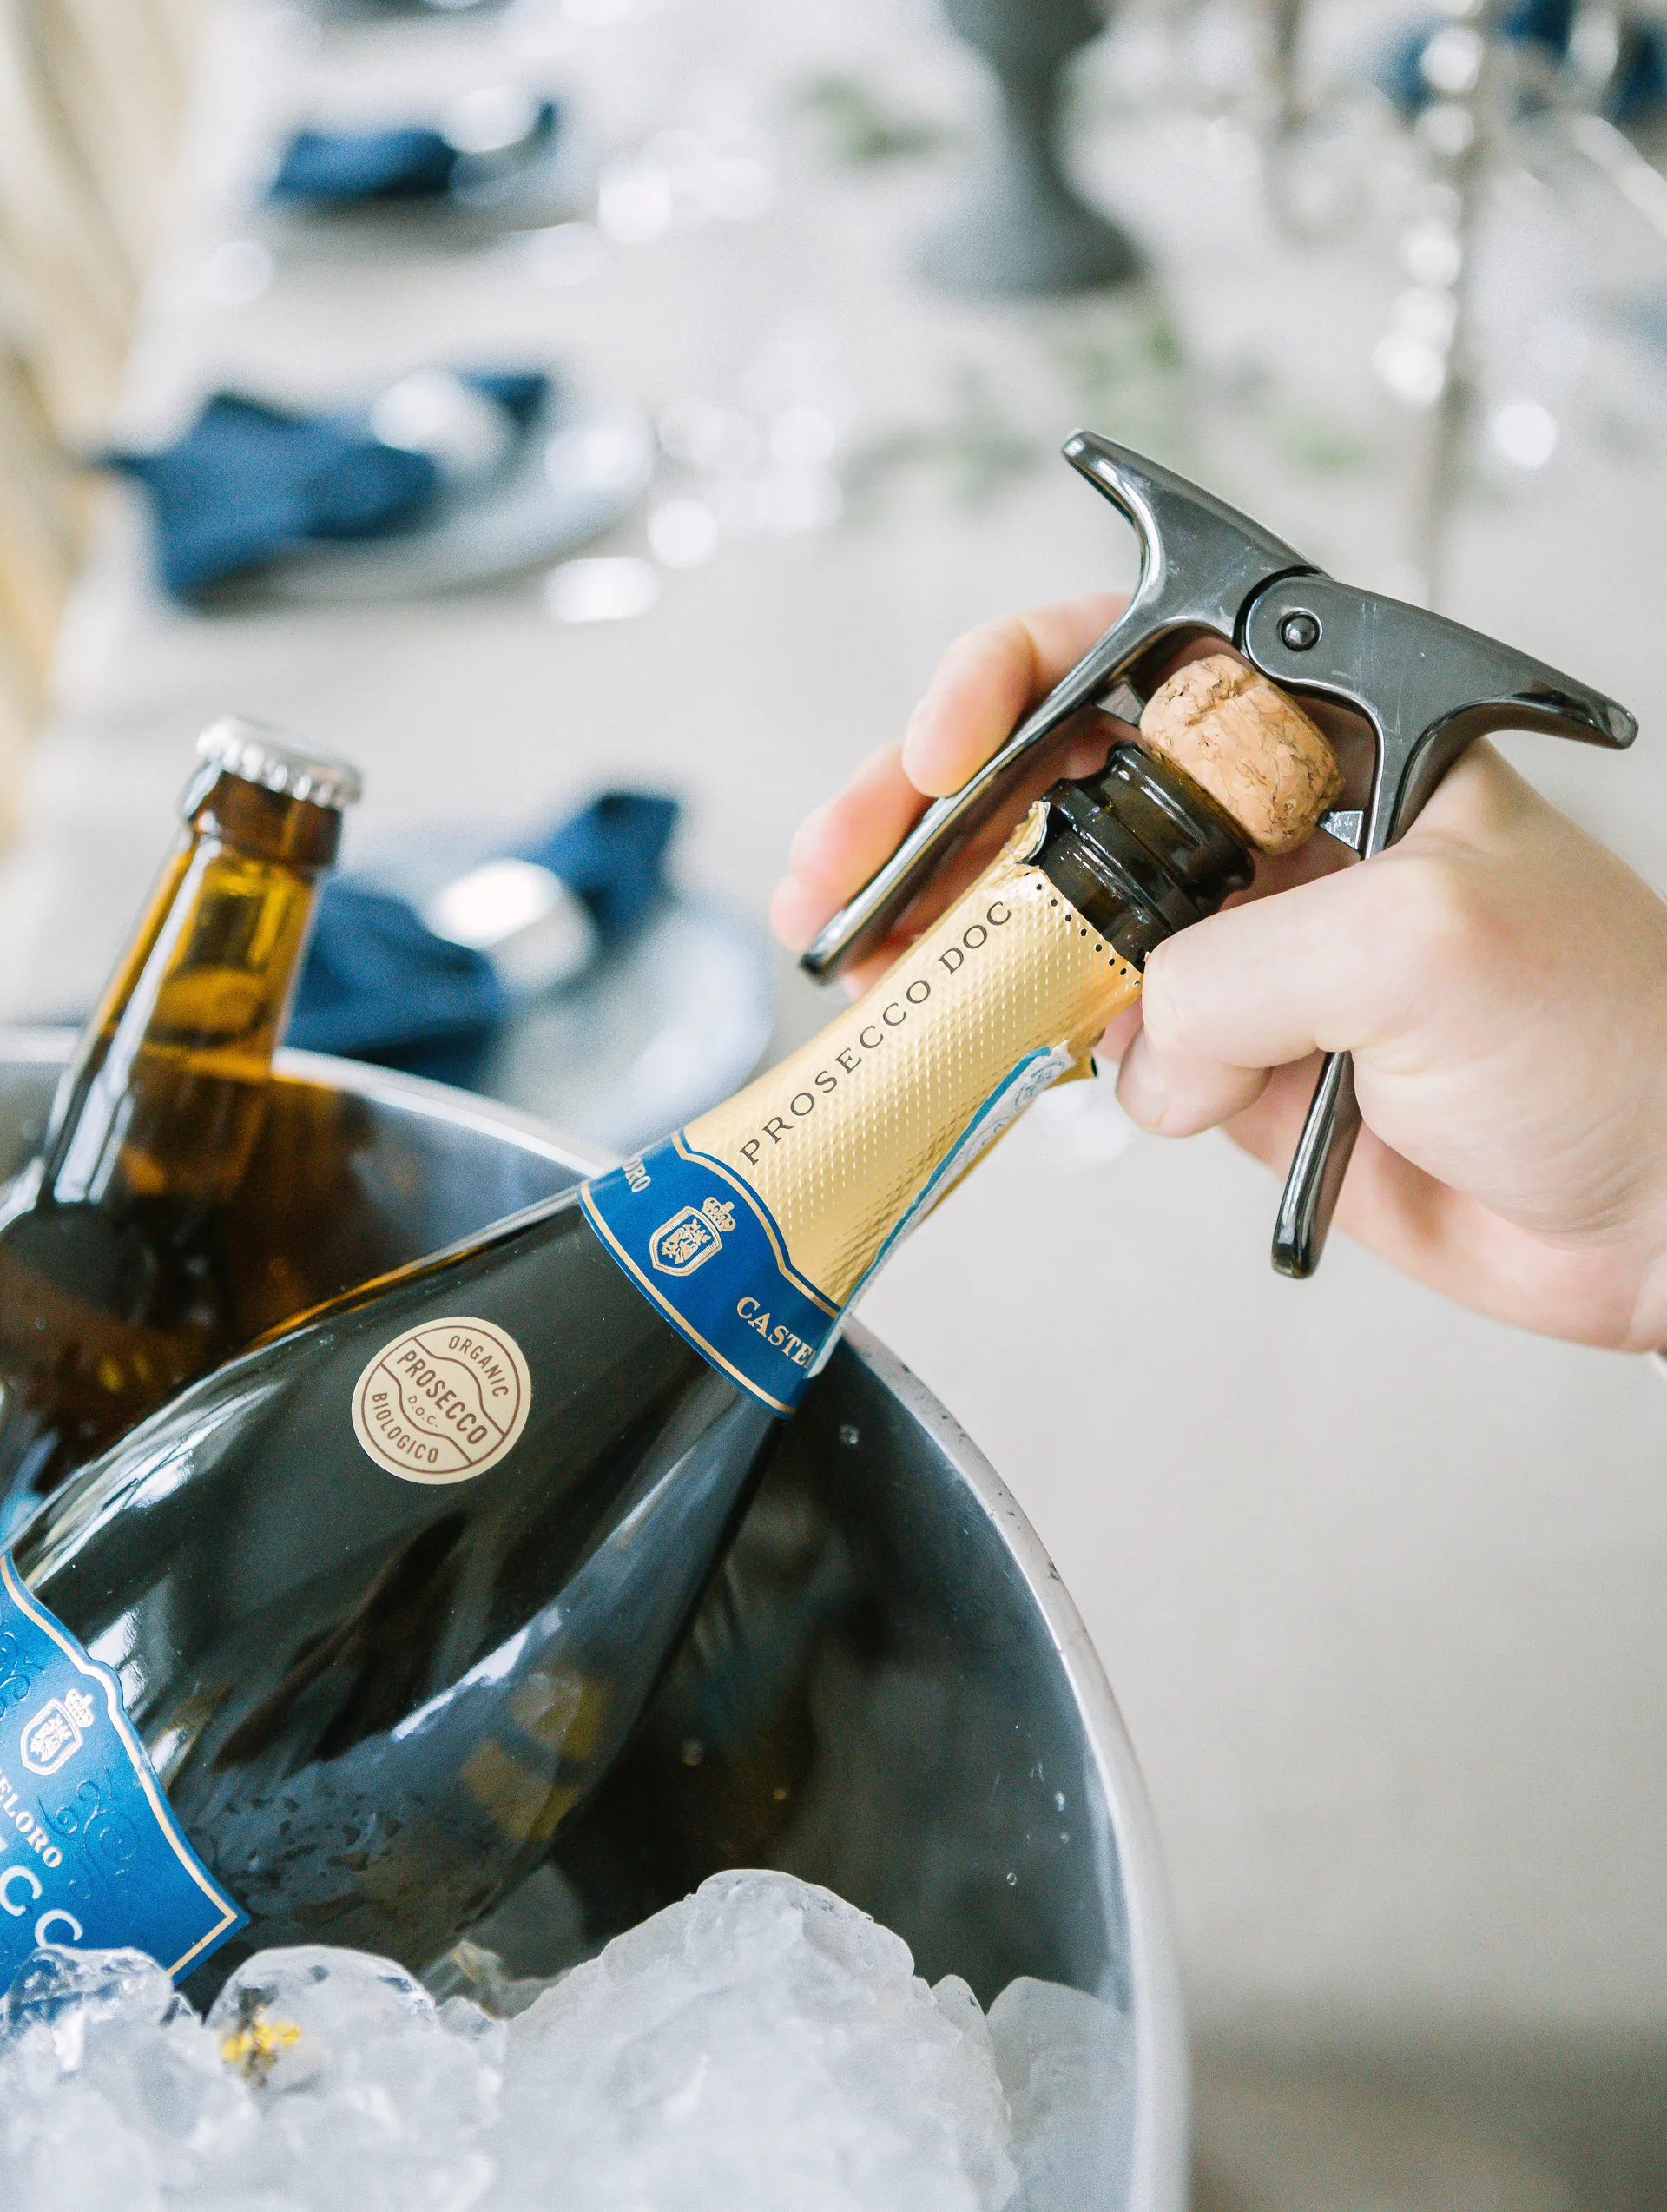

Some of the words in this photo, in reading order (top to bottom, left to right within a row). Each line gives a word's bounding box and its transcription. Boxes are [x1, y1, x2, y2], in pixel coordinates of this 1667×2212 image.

[739, 980, 931, 1165] PROSECCO
[938, 901, 1011, 974] DOC
[396, 1349, 488, 1445] PROSECCO
[448, 1335, 510, 1398] ORGANIC
[372, 1391, 438, 1464] BIOLOGICO
[407, 1395, 438, 1428] D.O.C.
[0, 1767, 63, 1868] ELORO
